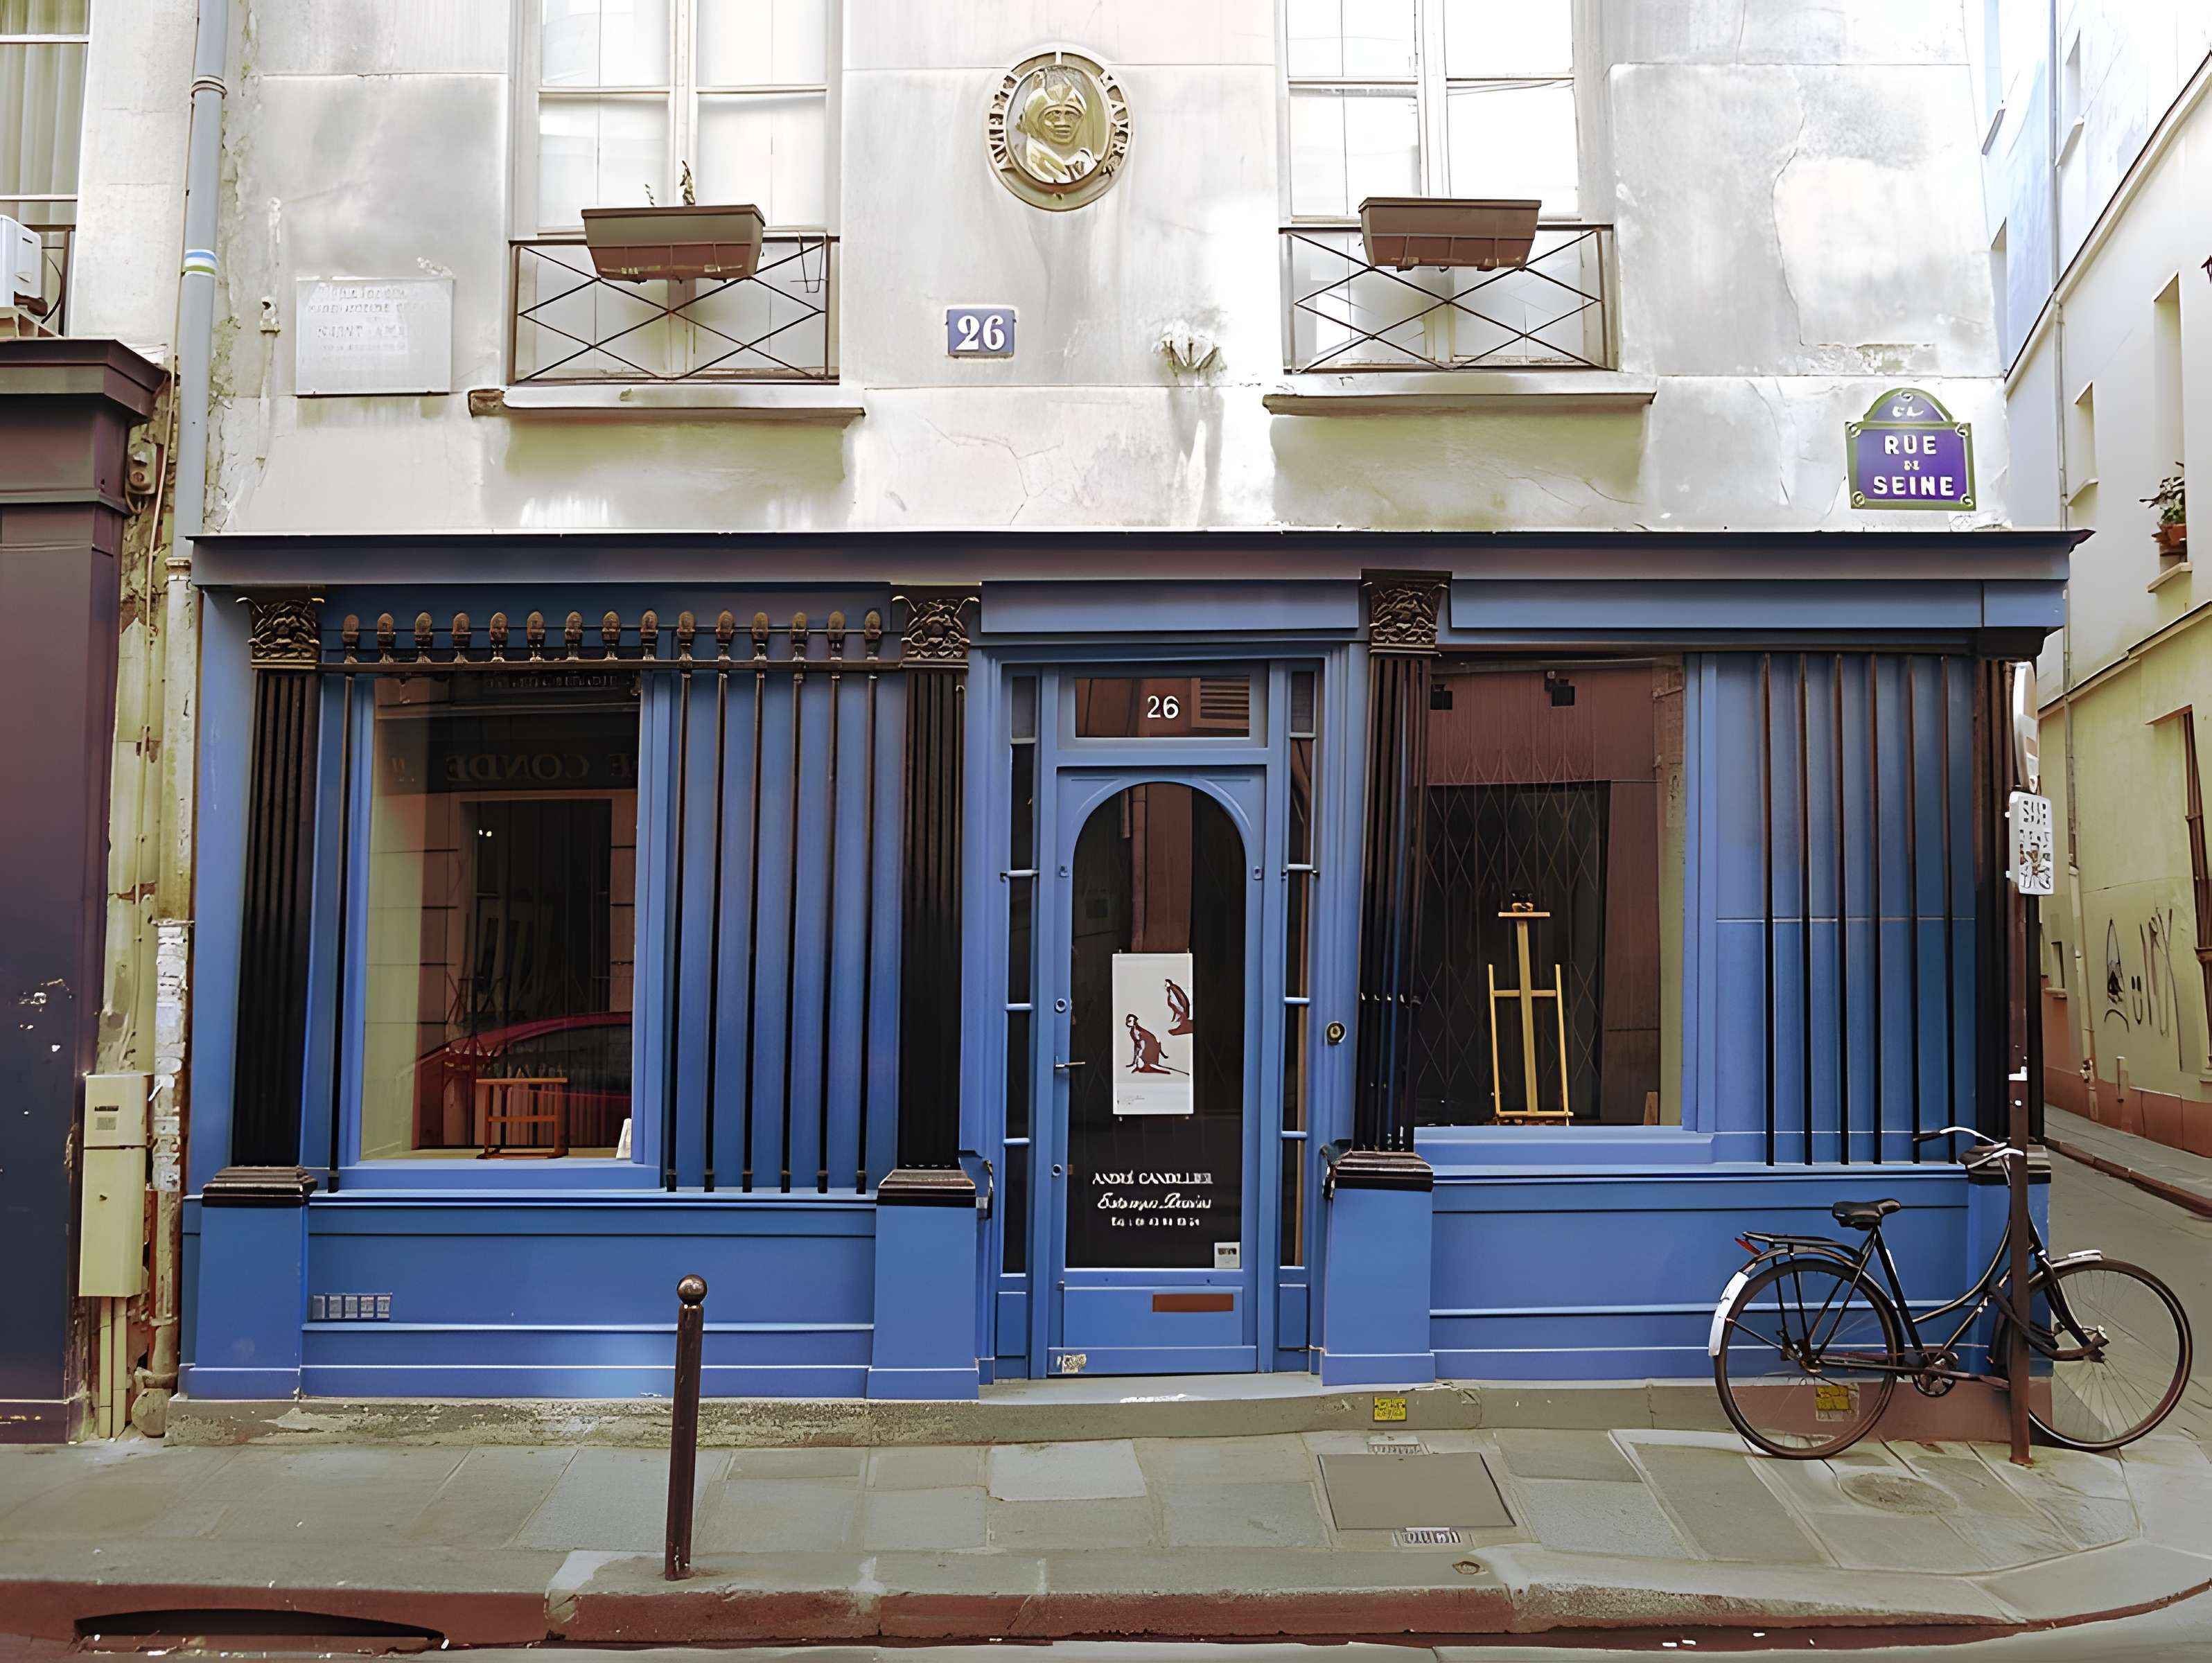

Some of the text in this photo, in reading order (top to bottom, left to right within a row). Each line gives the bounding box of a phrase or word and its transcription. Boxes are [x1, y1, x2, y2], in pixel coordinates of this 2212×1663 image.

[955, 315, 1005, 351] 26
[1884, 434, 1937, 455] RUE
[1873, 475, 1954, 496] SEINE
[1147, 695, 1179, 719] 26
